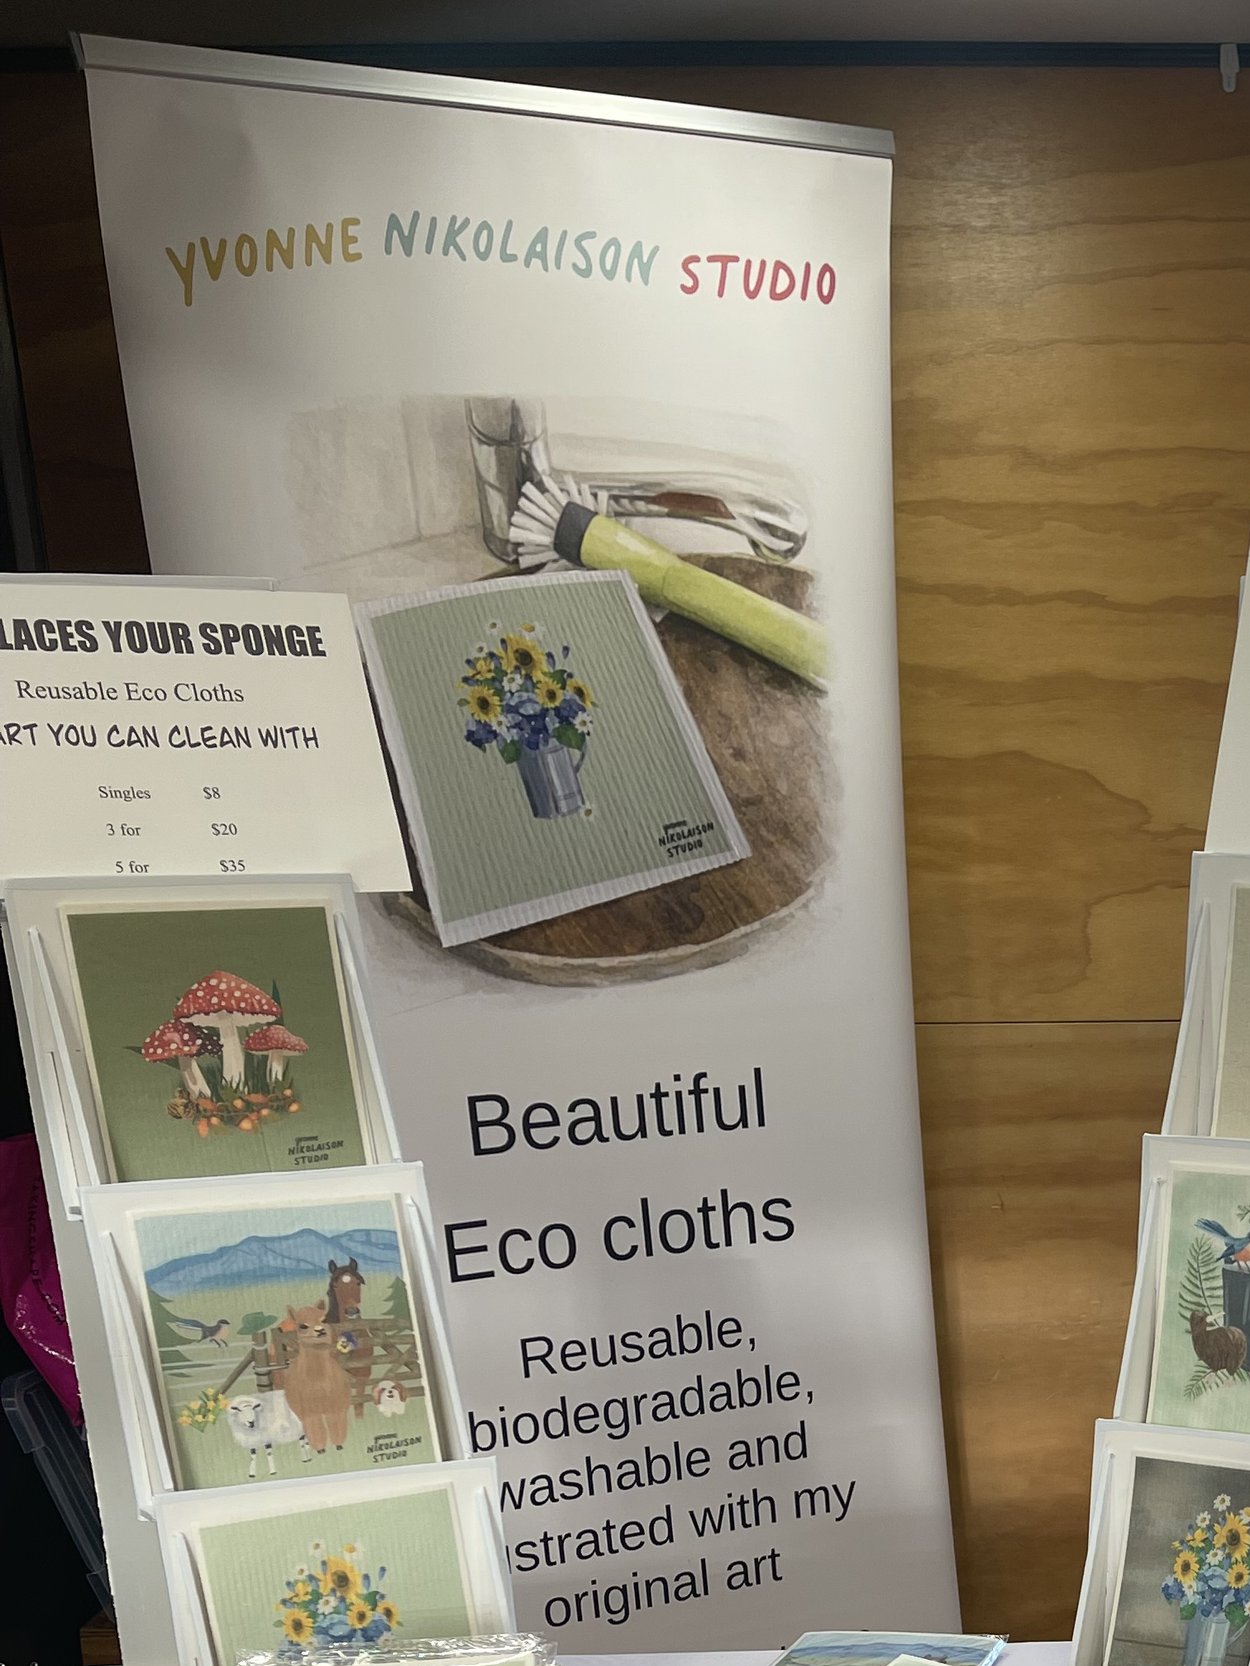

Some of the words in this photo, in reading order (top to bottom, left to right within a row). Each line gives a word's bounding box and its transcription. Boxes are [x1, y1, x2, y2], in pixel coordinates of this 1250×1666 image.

[165, 217, 363, 306] YVONNE
[384, 210, 660, 287] NIKOLAISON
[679, 254, 837, 305] STUDIO
[102, 620, 195, 655] YOUR
[199, 622, 327, 658] SPONGE
[15, 679, 118, 701] Reusable
[124, 682, 167, 702] Eco
[173, 682, 244, 703] Cloths
[47, 723, 97, 747] YOU
[107, 725, 160, 748] CAN
[168, 725, 252, 749] CLEAN
[257, 725, 319, 750] WITH
[98, 785, 151, 802] Singles
[202, 785, 221, 801] $8
[105, 823, 115, 836] 3
[120, 822, 142, 837] for
[211, 822, 238, 837] $20
[658, 822, 714, 846] NIKOLAISON
[667, 840, 703, 858] STUDIO
[115, 860, 124, 873] 5
[128, 860, 150, 874] for
[219, 859, 246, 873] $35
[466, 1067, 767, 1156] Beautiful
[288, 1140, 344, 1155] NIKOLAISON
[294, 1153, 329, 1165] STUDIO
[443, 1218, 578, 1283] Eco
[602, 1188, 796, 1262] cloths
[520, 1309, 757, 1379] Reusable,
[468, 1364, 815, 1453] biodegradable,
[373, 1450, 407, 1463] STUDIO
[727, 1420, 809, 1471] and
[505, 1504, 674, 1575] strated
[689, 1487, 778, 1538] with
[793, 1479, 857, 1522] my
[543, 1557, 710, 1628] original
[726, 1547, 783, 1590] art
